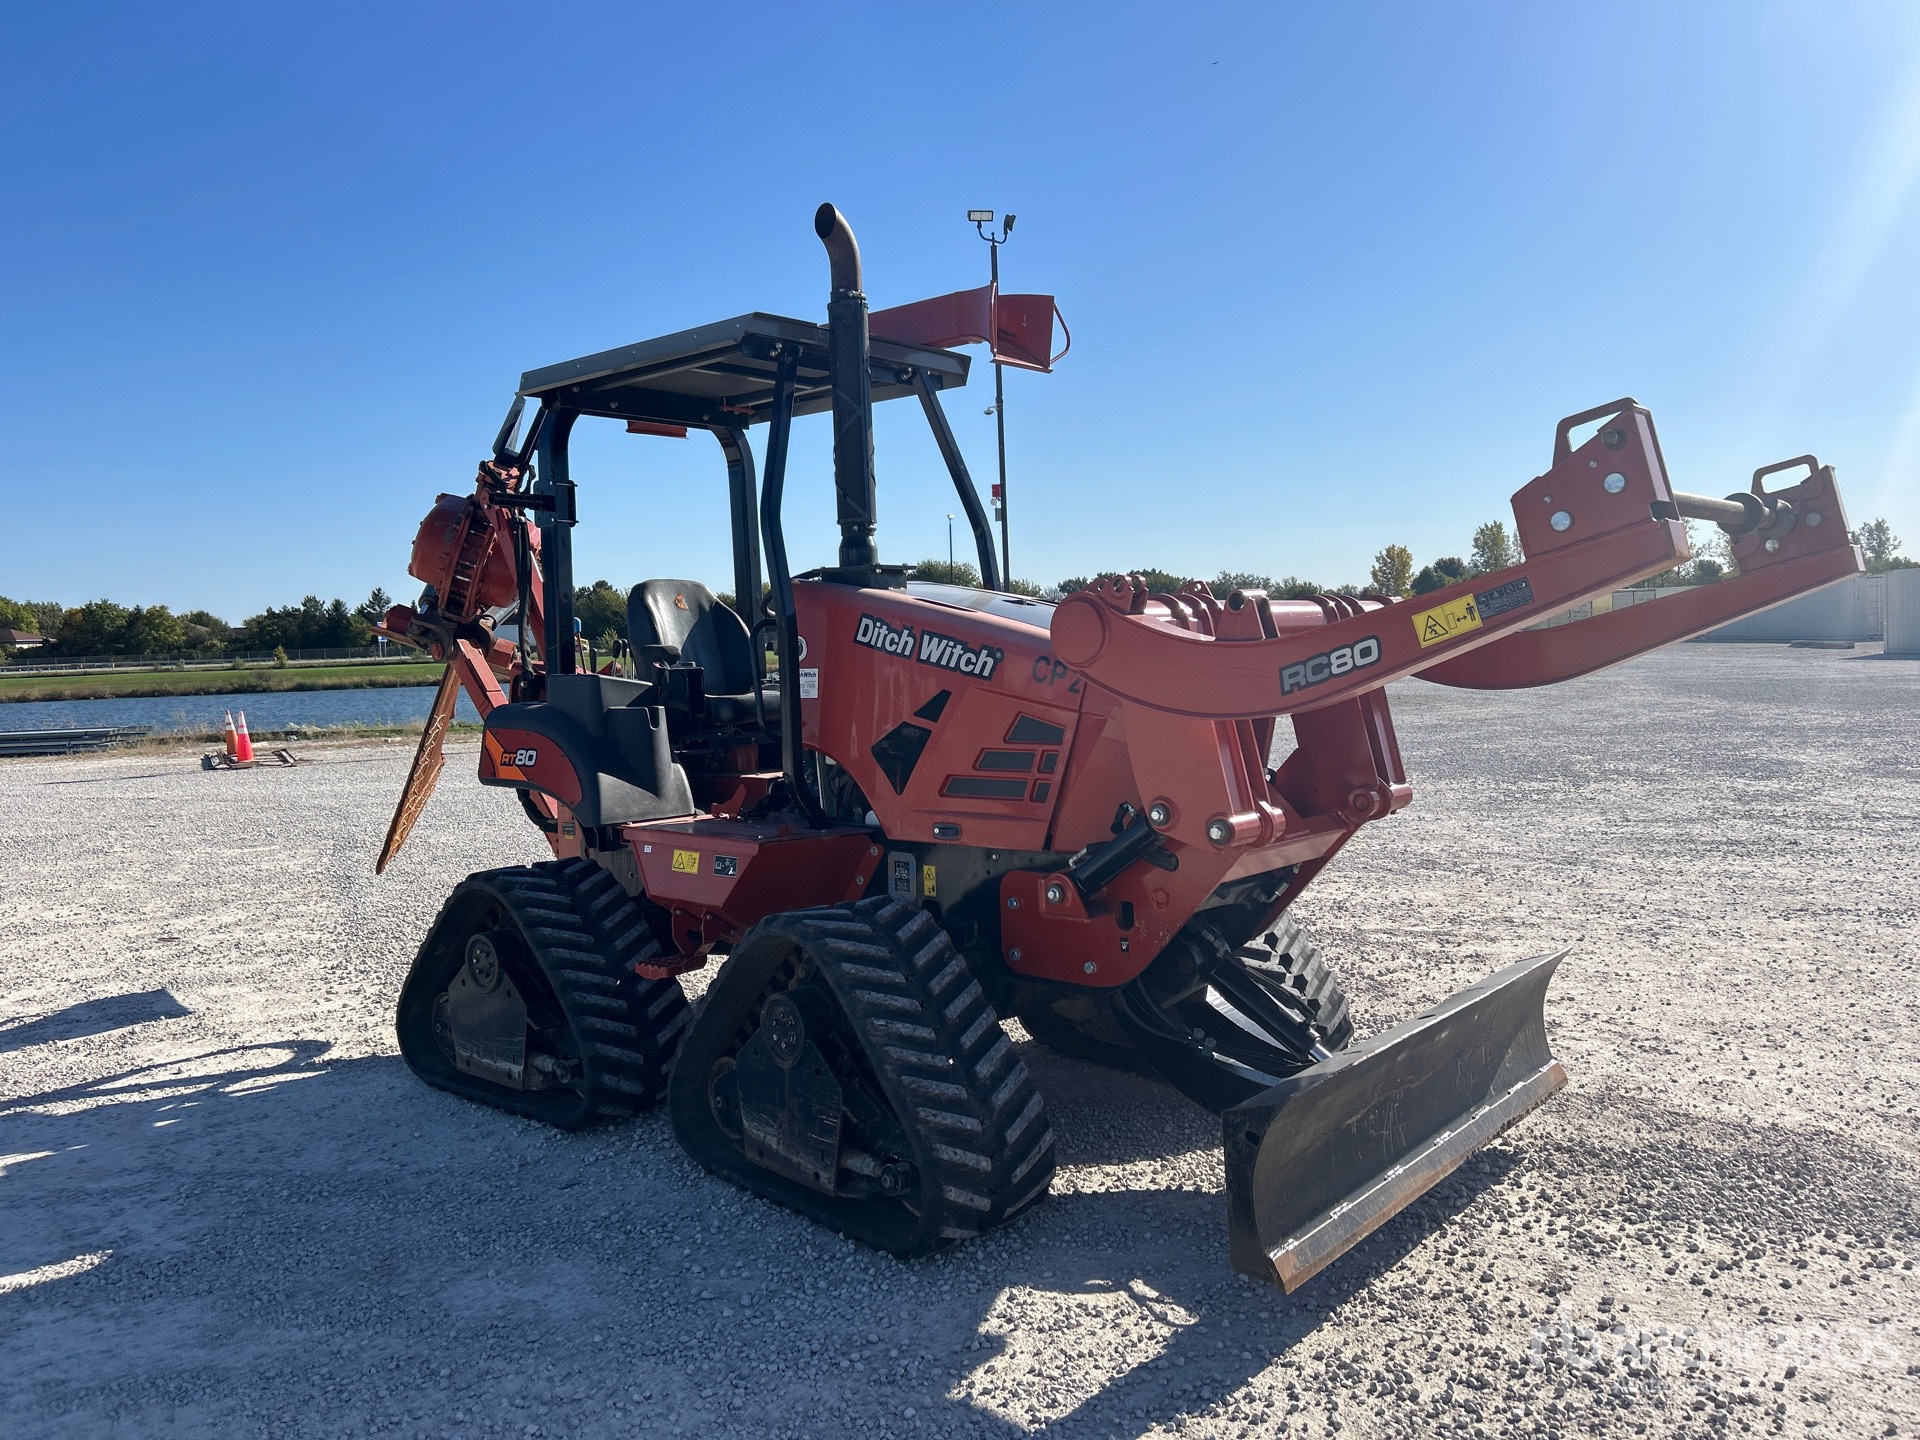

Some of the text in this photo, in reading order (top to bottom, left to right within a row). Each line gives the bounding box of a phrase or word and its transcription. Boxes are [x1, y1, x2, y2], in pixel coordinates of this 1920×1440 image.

[856, 617, 915, 656] Ditch
[1032, 655, 1069, 687] CP
[1281, 638, 1379, 692] RC80
[501, 749, 537, 766] RT80
